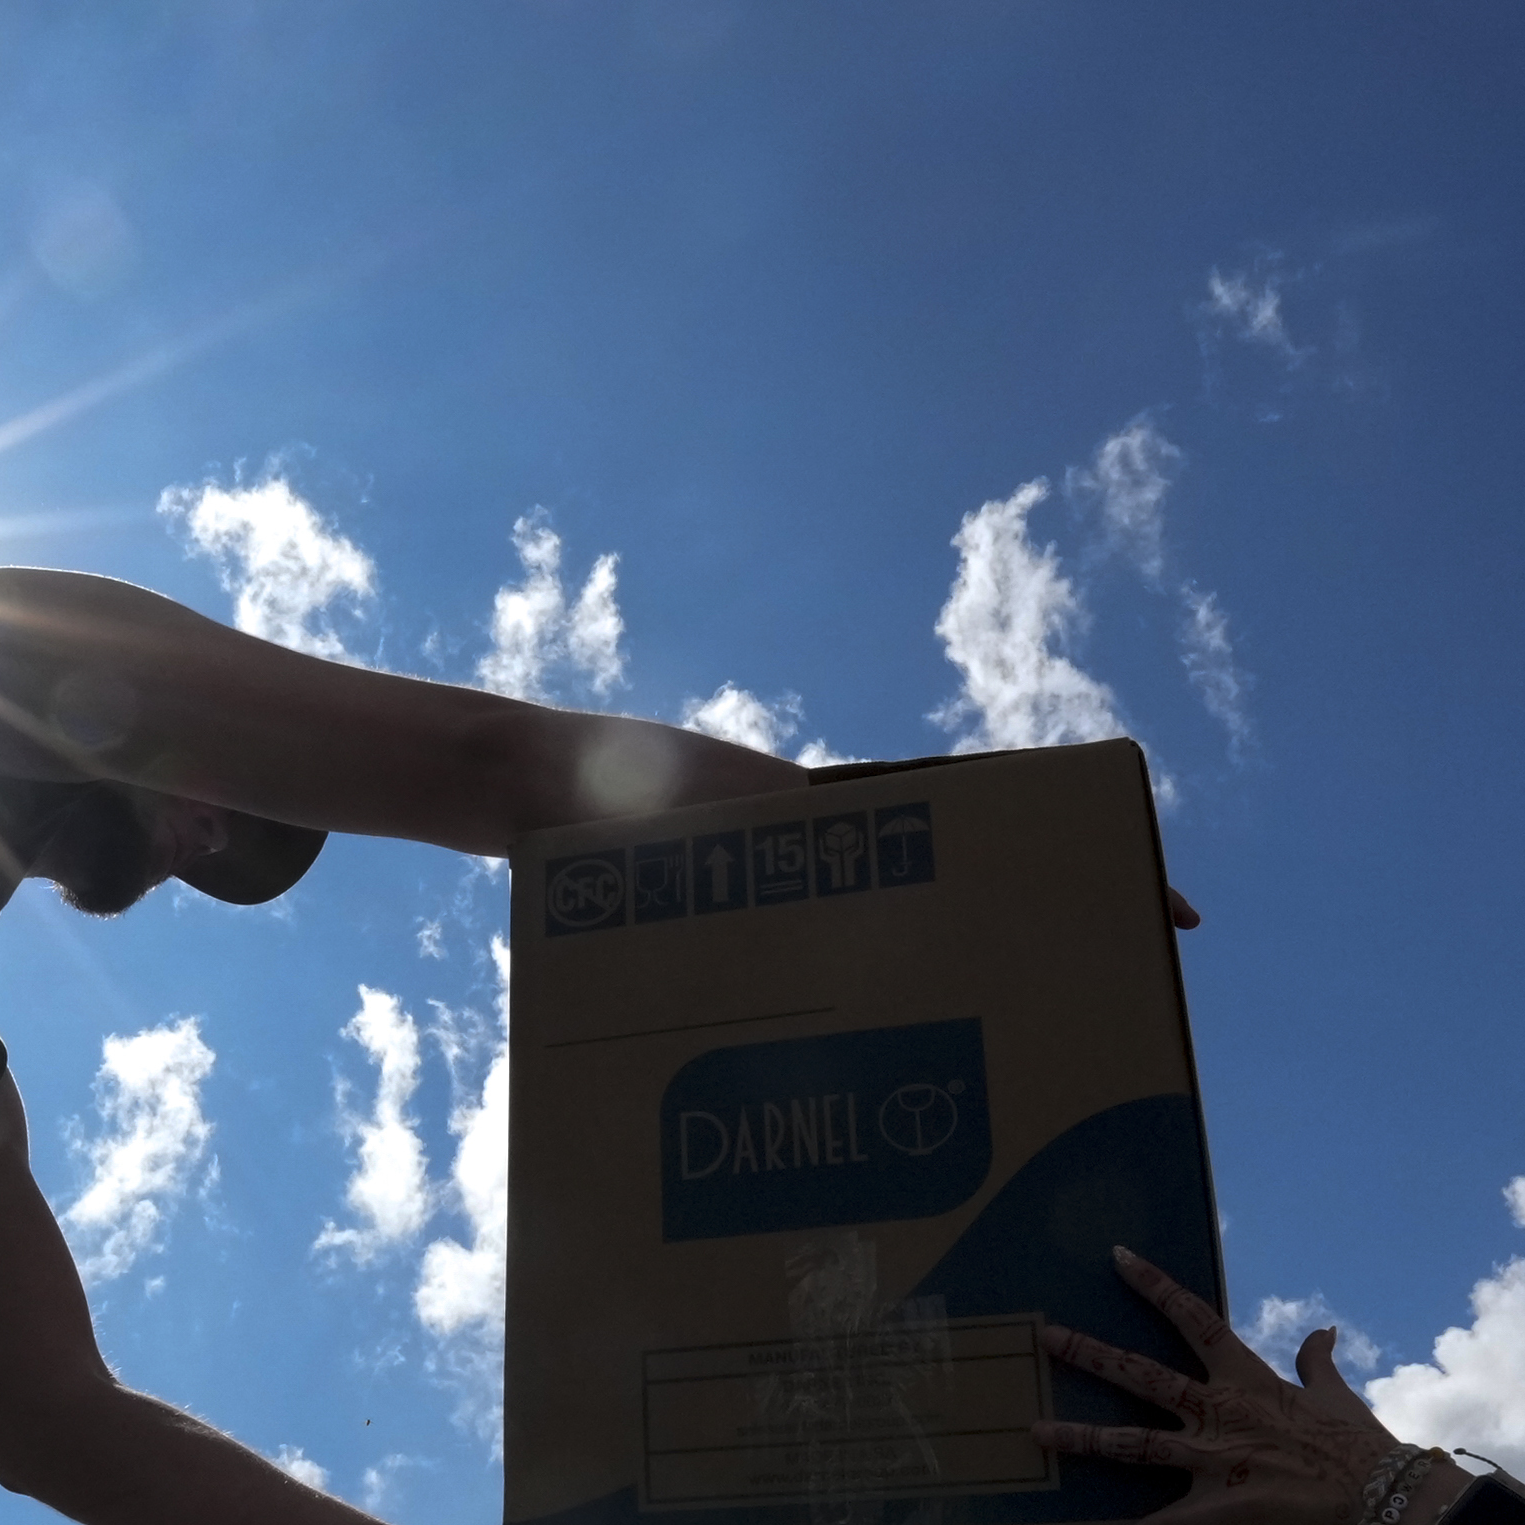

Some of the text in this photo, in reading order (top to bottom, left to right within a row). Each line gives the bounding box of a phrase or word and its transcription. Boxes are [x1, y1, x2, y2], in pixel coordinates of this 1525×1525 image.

[756, 832, 806, 877] 15
[555, 870, 618, 913] CFC
[679, 1091, 870, 1182] DARNEL
[1384, 1460, 1430, 1520] POWER
